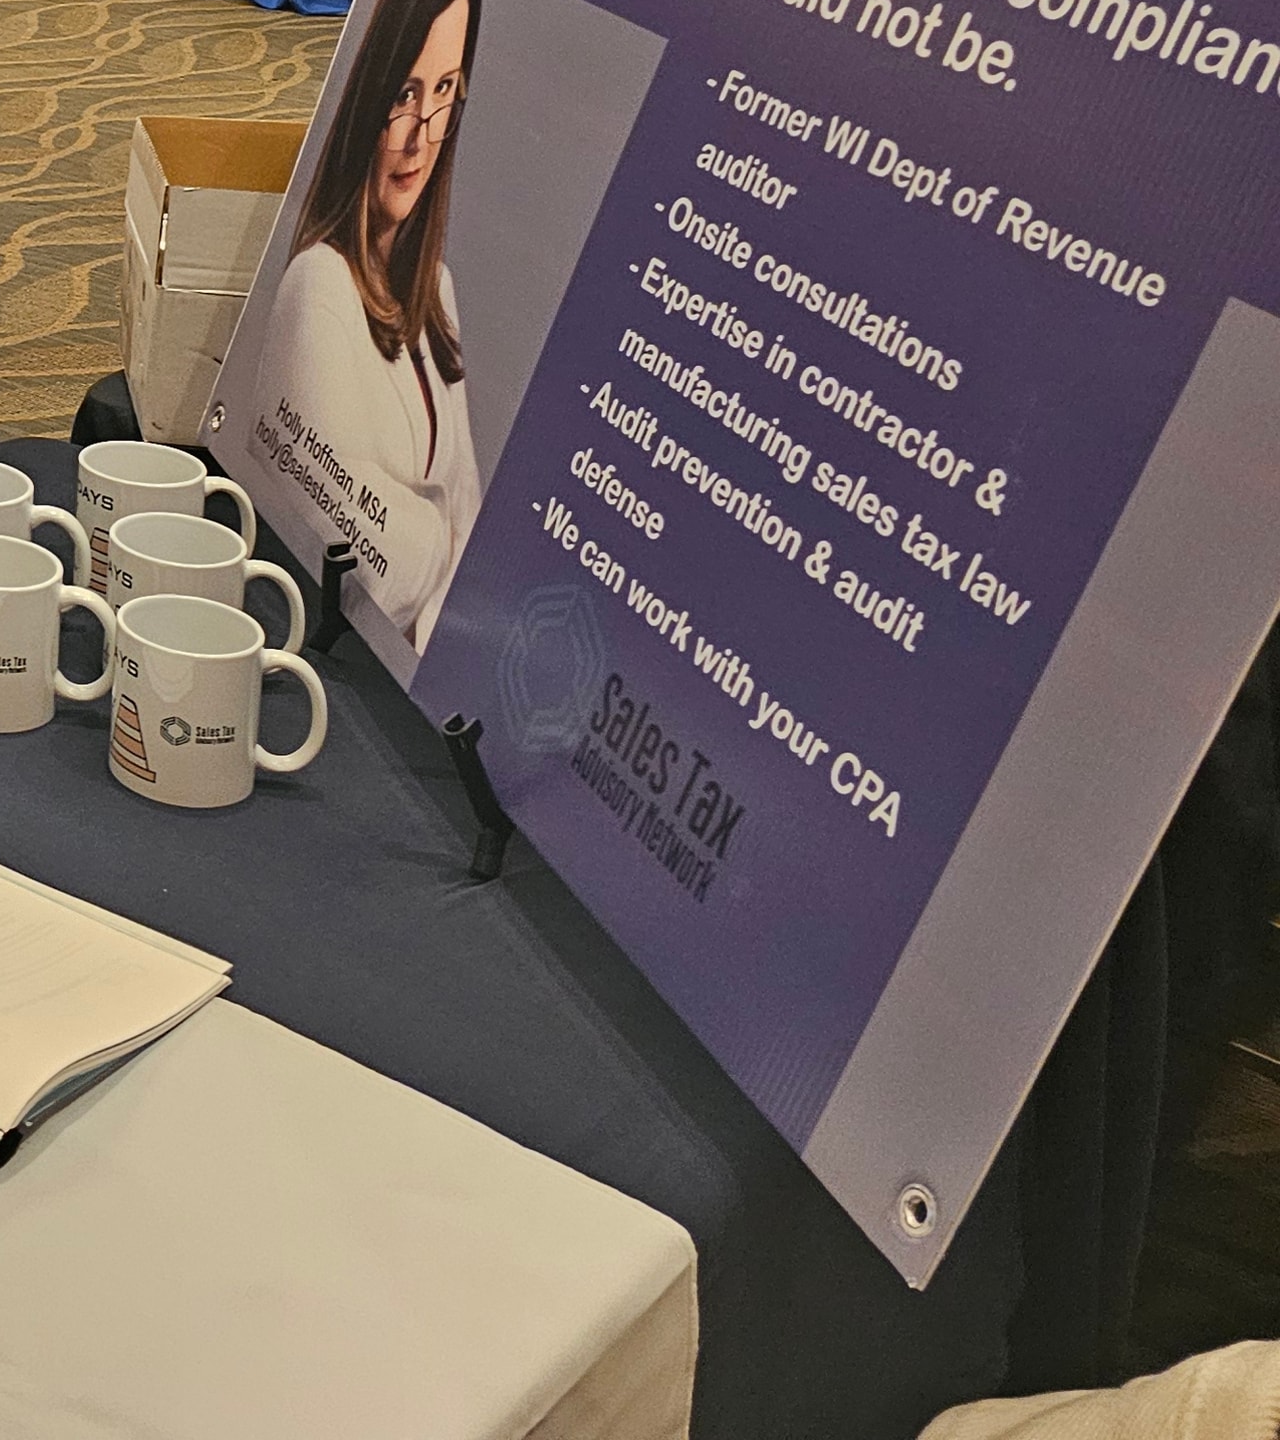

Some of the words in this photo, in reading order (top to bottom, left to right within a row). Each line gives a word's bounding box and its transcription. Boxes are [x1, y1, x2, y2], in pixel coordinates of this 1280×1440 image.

[941, 11, 1016, 91] be.
[695, 143, 797, 209] auditor
[823, 115, 870, 164] WI
[866, 137, 951, 205] Dept
[951, 185, 999, 223] of
[995, 196, 1165, 306] Revenue
[753, 254, 962, 390] consultations
[276, 397, 305, 444] Holly
[302, 426, 353, 502] Hoffman,
[356, 484, 387, 532] MSA
[570, 447, 664, 539] defense
[617, 328, 812, 483] manufacturing
[811, 461, 899, 536] sales
[901, 513, 960, 580] tax
[959, 552, 1031, 625] law
[764, 334, 796, 380] in
[798, 365, 974, 487] contractor
[974, 468, 1007, 516] &
[258, 421, 388, 578] holly@salestaxlady.com
[651, 435, 802, 560] prevention
[803, 539, 832, 584] &
[833, 570, 924, 652] audit
[13, 656, 27, 666] Tax
[196, 726, 221, 738] Sales
[222, 726, 235, 737] Tax
[579, 540, 625, 593] can
[626, 578, 692, 652] work
[693, 636, 754, 706] with
[747, 691, 829, 765] your
[830, 751, 900, 837] CPA
[589, 671, 679, 794] Sales
[673, 748, 746, 859] Tax
